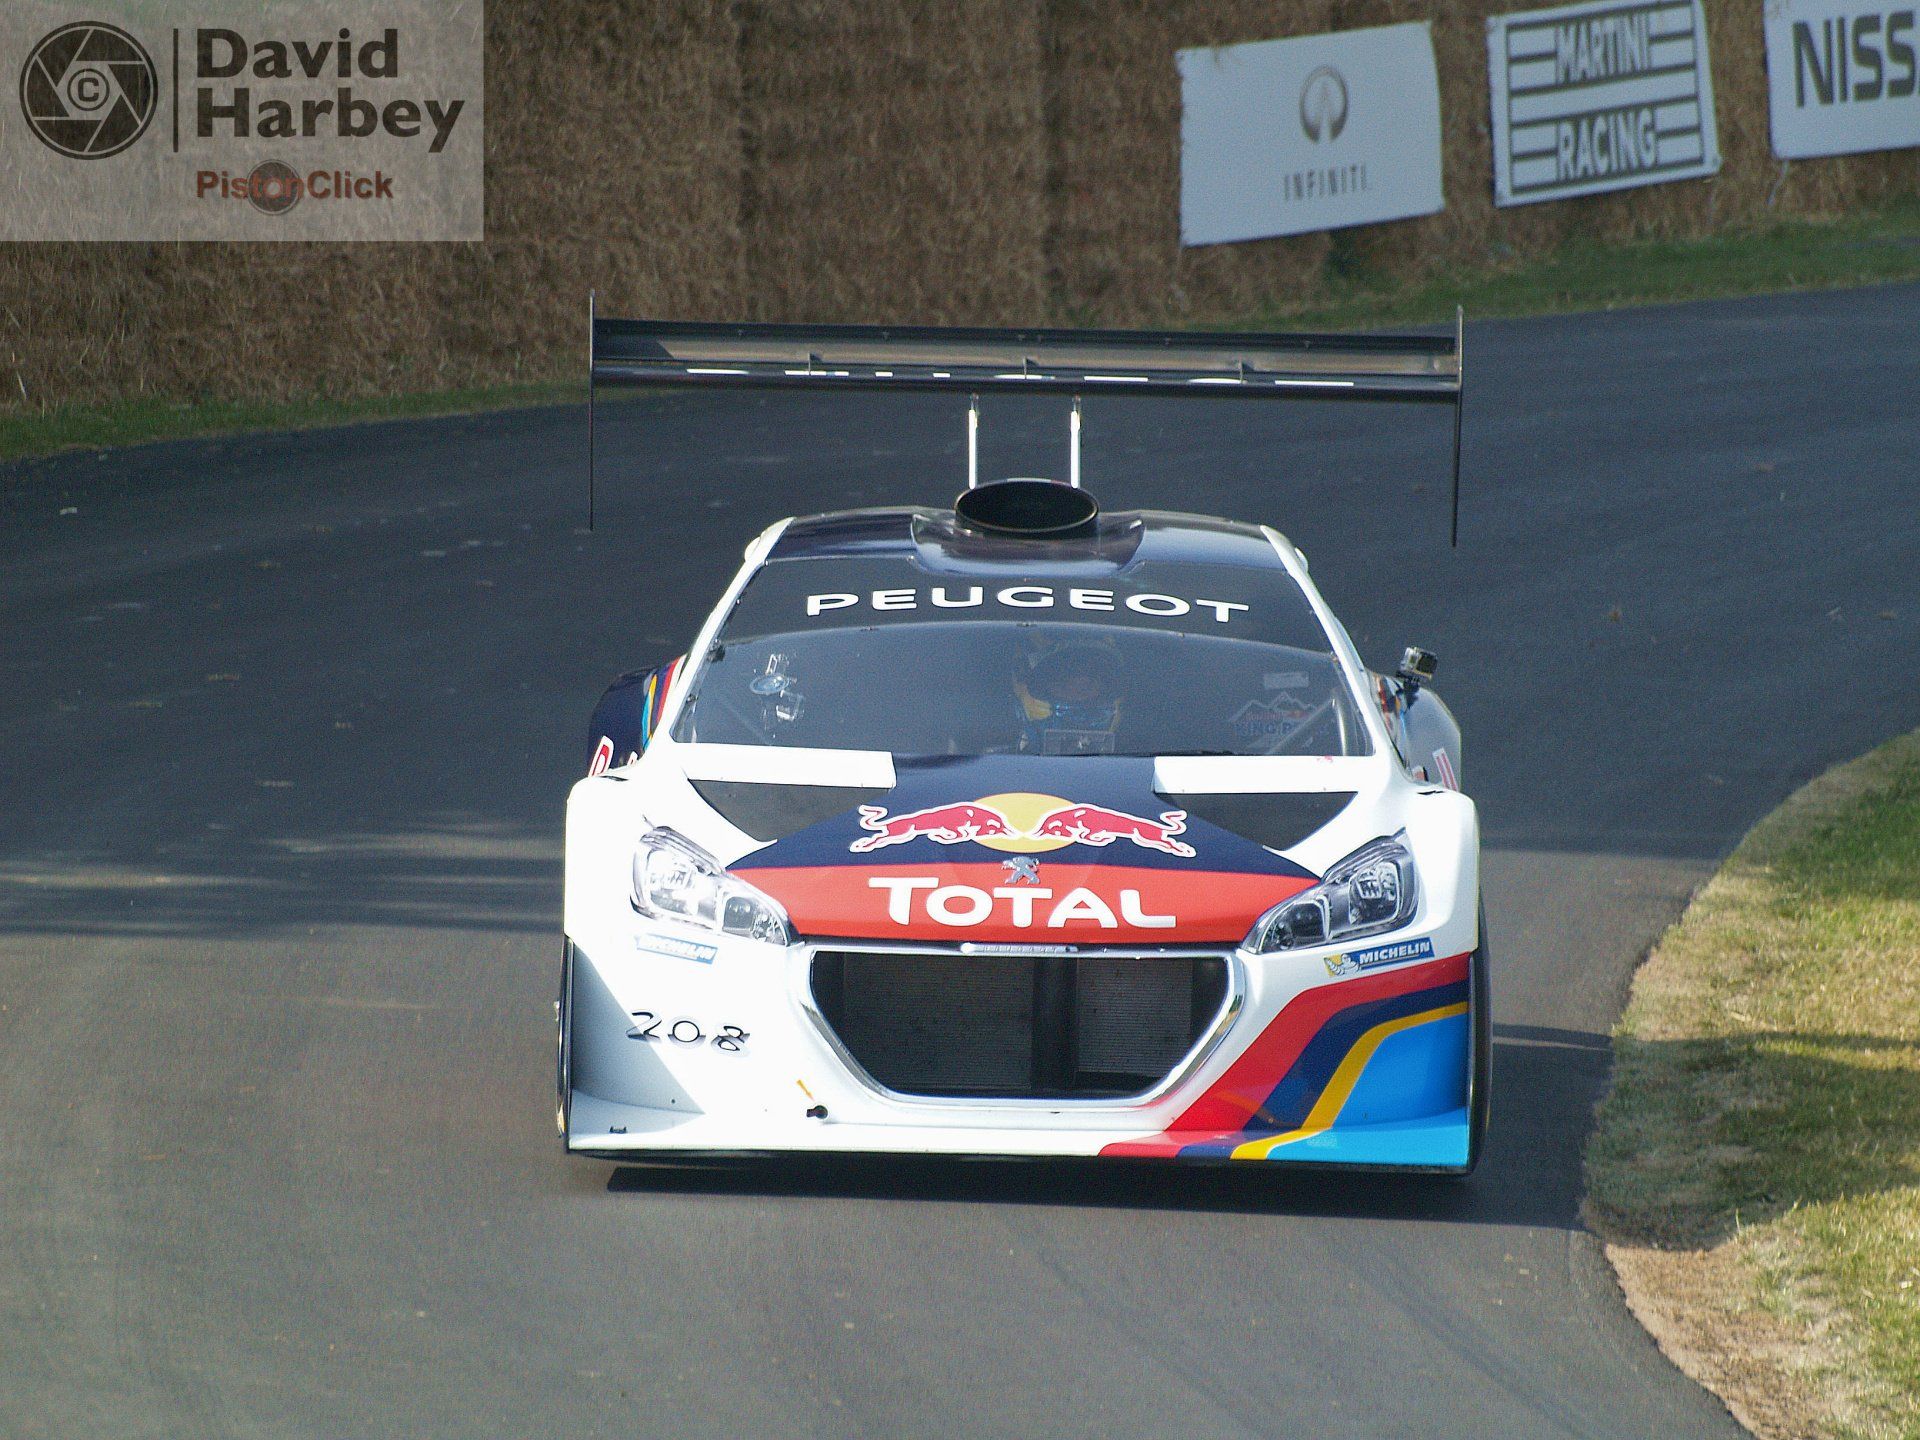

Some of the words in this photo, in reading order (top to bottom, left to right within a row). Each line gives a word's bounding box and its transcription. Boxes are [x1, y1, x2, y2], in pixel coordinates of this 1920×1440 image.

[1556, 13, 1650, 84] MARTINI
[1792, 10, 1920, 108] NISS
[1556, 107, 1657, 183] RACING
[1283, 164, 1368, 203] INFINITI
[807, 586, 1250, 623] PEUGEOT
[868, 877, 1177, 928] TOTAL
[1359, 941, 1430, 965] MICHELIN
[625, 1010, 751, 1056] 208
